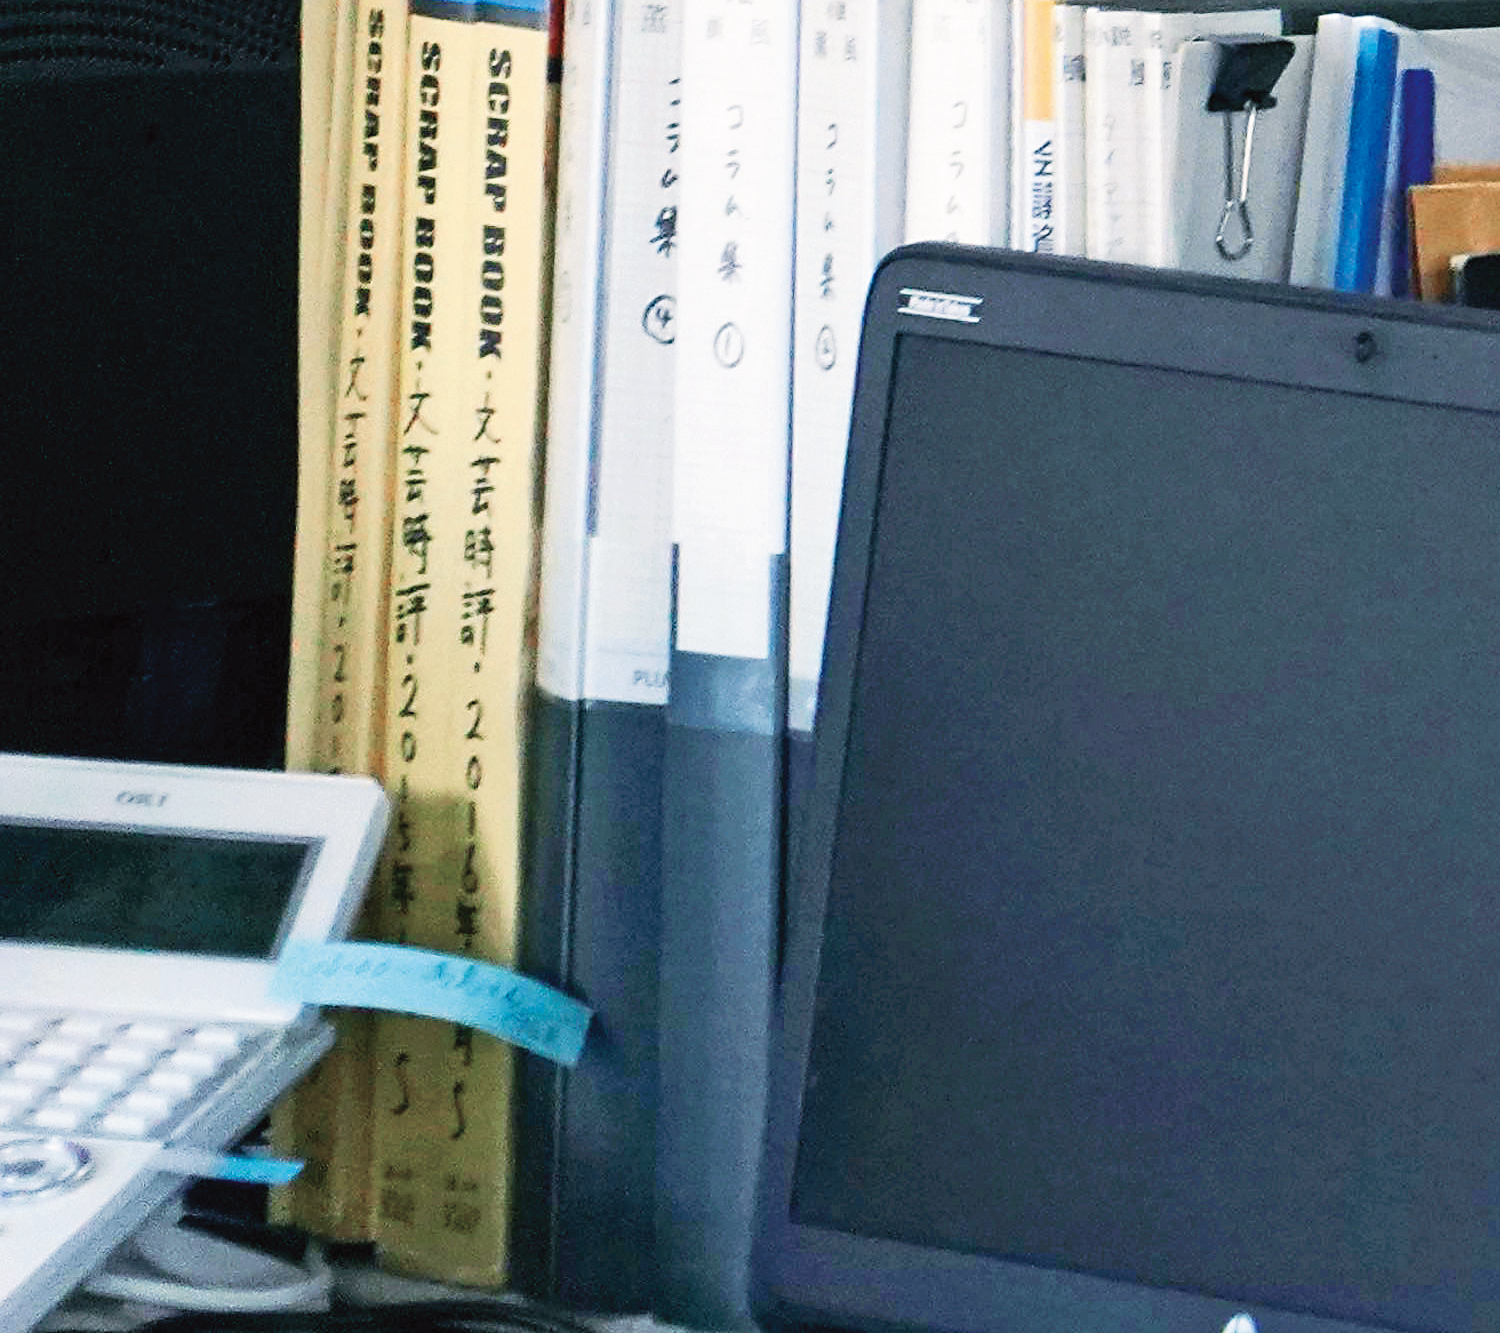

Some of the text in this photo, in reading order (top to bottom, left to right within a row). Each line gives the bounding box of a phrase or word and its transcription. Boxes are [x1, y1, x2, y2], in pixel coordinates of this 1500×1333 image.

[355, 8, 385, 318] SCRAP BOOK
[410, 40, 442, 353] SCRAP BOOK
[478, 47, 513, 360] SCRAP BOOK
